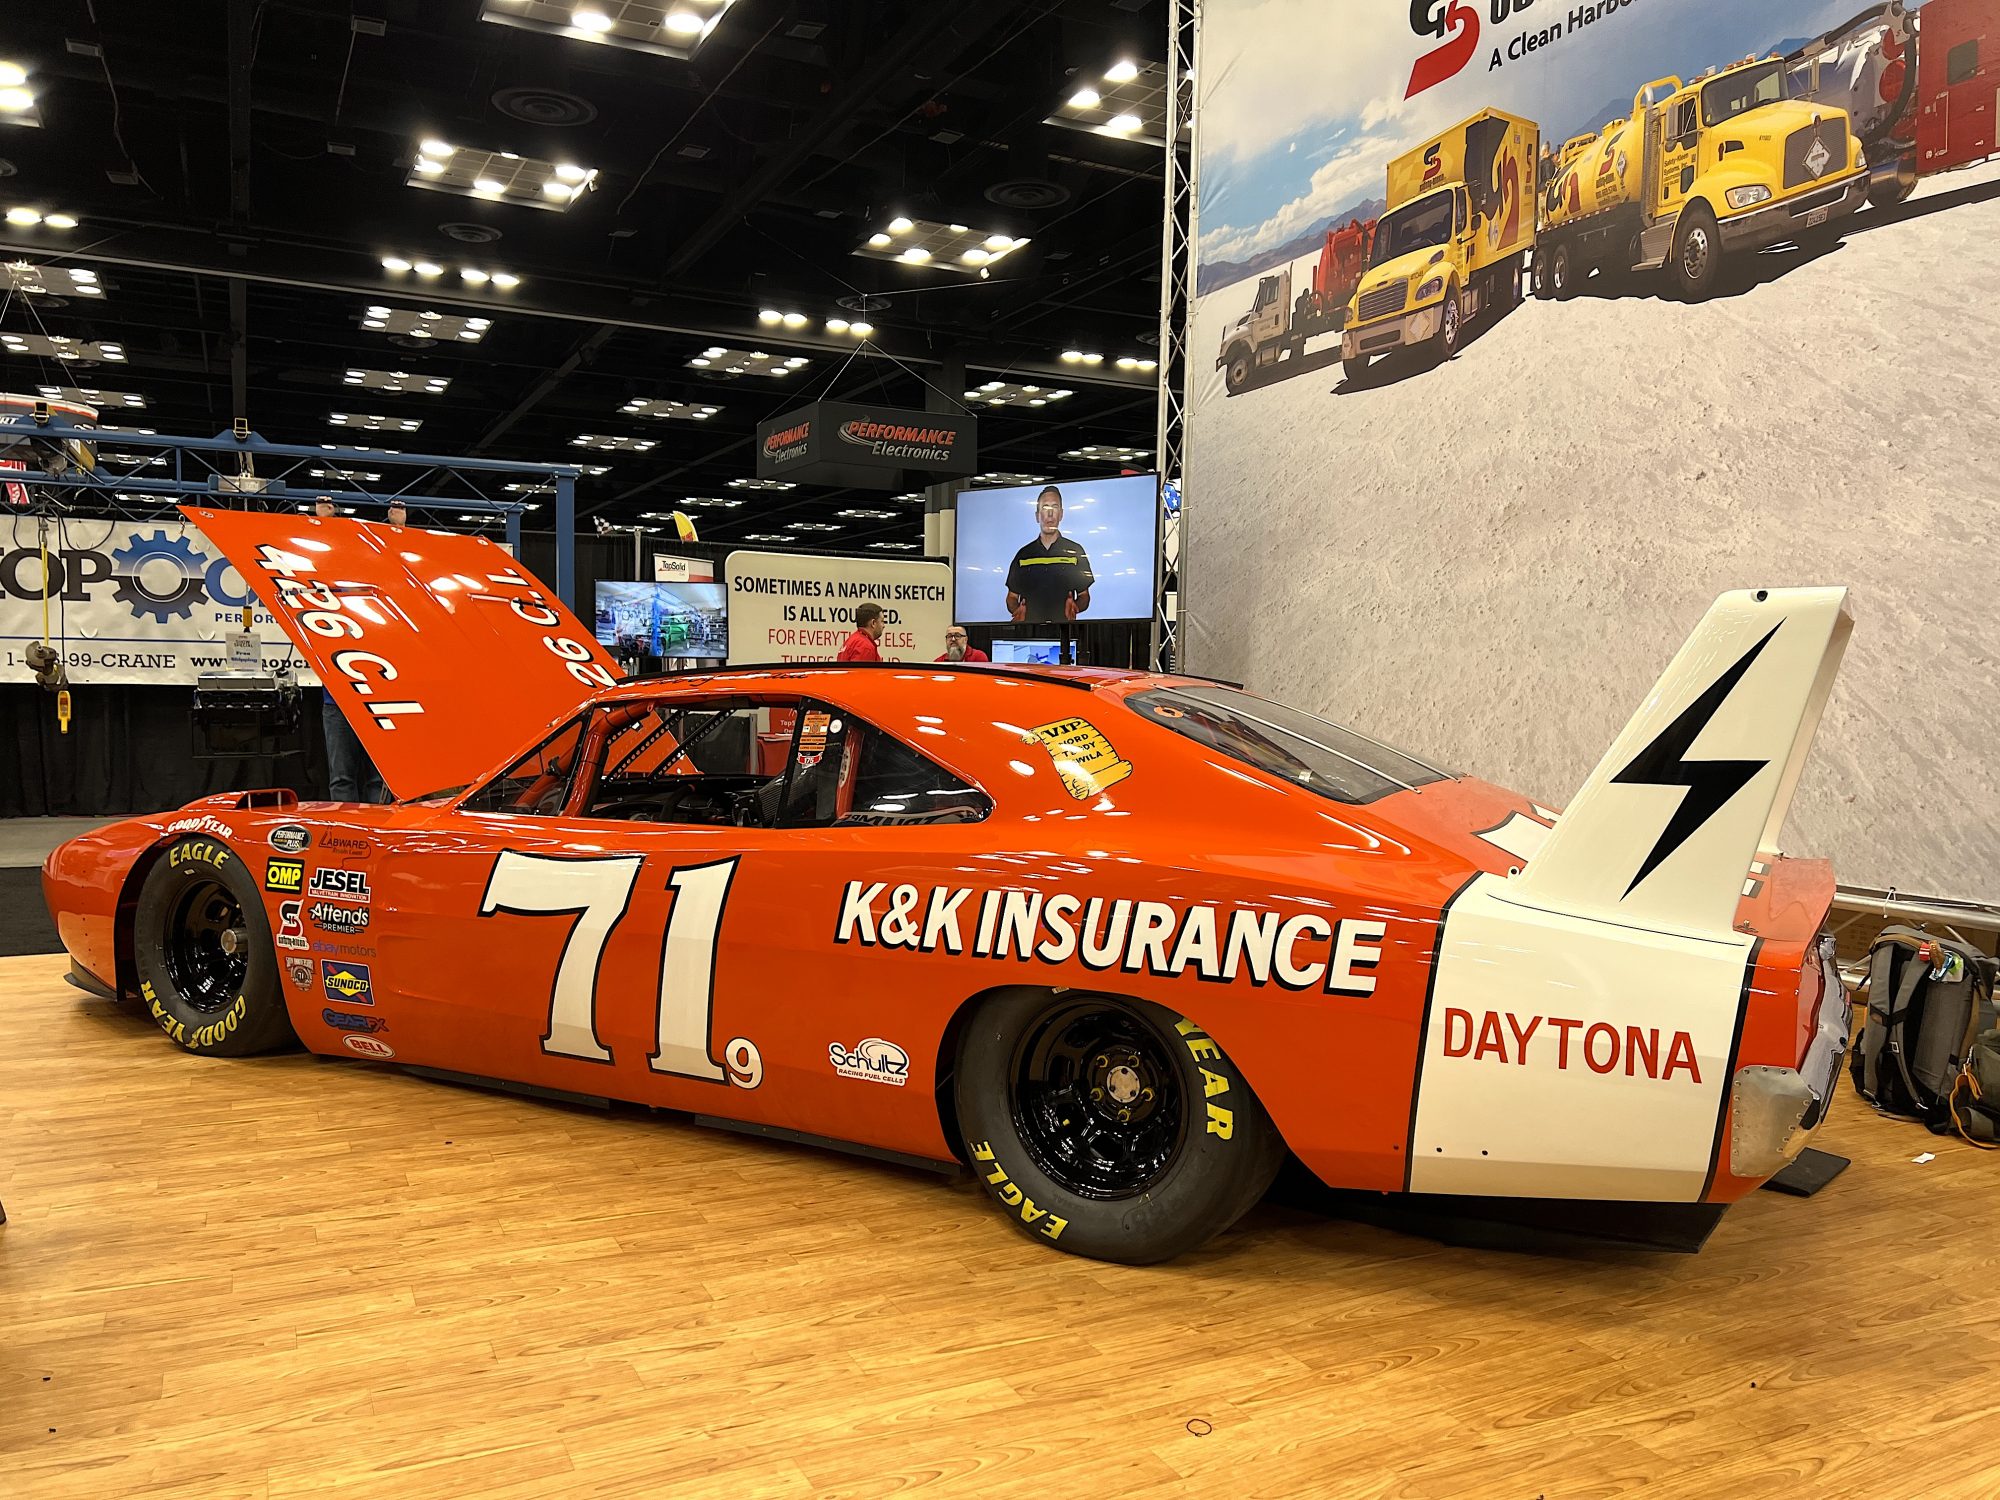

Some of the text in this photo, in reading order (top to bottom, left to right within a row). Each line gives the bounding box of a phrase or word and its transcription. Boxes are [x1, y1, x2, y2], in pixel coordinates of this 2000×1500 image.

[1488, 48, 1503, 72] A
[1507, 22, 1562, 61] Clean
[1567, 0, 1643, 34] Harbo
[767, 421, 811, 449] PERFORMANCE
[848, 421, 957, 446] PERFORMANCE
[774, 441, 808, 464] Electronics
[872, 440, 950, 461] Electronics
[0, 547, 112, 602] OP
[254, 544, 364, 640] 426
[734, 576, 945, 601] SOMETIMES A NAPKIN SKETCH
[215, 613, 278, 624] PEROR
[783, 605, 796, 621] IS
[800, 607, 827, 622] ALL
[768, 628, 796, 645] FOR
[884, 632, 916, 650] ELSE,
[7, 652, 176, 668] 1--99-CRANE
[1042, 720, 1082, 738] VIP
[1058, 734, 1089, 746] ORD
[169, 842, 230, 870] EAGLE
[268, 866, 301, 885] OMP
[310, 868, 370, 895] JESEL
[309, 902, 369, 926] Attends
[322, 922, 355, 933] PREMIER
[833, 880, 1388, 997] K&K INSURANCE
[477, 848, 763, 1089] 71 9
[327, 978, 367, 991] SUNOCO
[349, 1038, 387, 1053] BELL
[1443, 1007, 1703, 1084] DAYTONA
[830, 1044, 908, 1077] Schultz
[838, 1068, 903, 1084] RACING FUEL CELLS
[969, 1140, 1070, 1241] EAGLE
